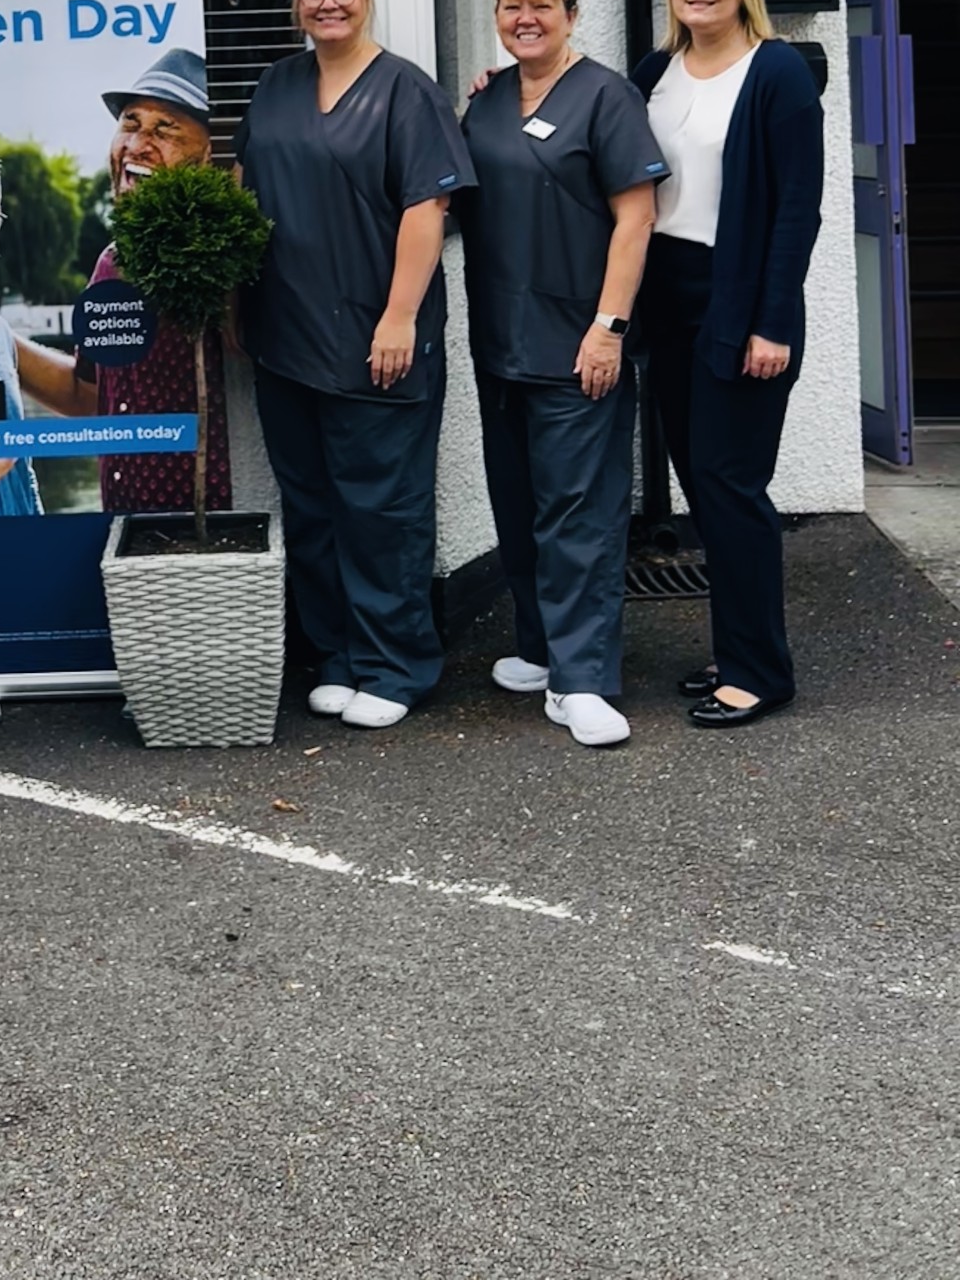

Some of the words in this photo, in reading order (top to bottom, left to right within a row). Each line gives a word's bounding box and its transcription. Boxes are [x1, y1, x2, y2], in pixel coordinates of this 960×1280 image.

[84, 300, 145, 315] Payment
[89, 316, 141, 331] options
[3, 431, 35, 446] free
[38, 427, 133, 444] consultation
